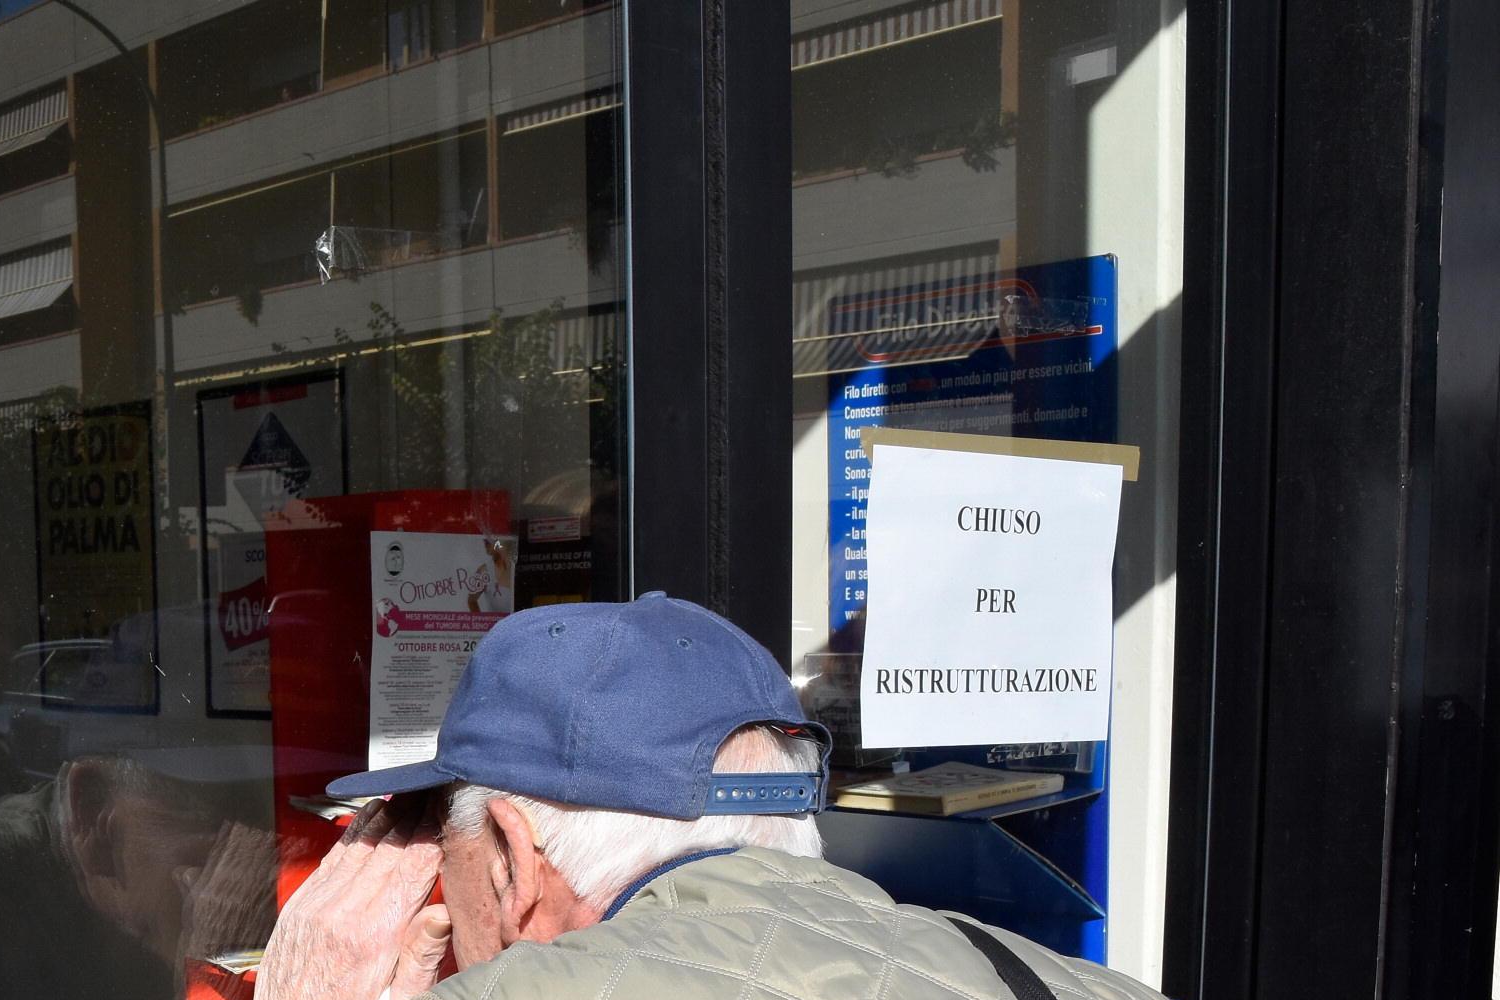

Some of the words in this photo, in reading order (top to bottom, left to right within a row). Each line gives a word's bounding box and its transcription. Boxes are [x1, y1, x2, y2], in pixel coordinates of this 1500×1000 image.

[844, 385, 860, 400] Filo
[861, 382, 889, 398] diretto
[891, 382, 907, 394] con
[941, 377, 953, 389] un
[955, 372, 981, 387] modo
[982, 370, 992, 384] in
[994, 367, 1009, 386] più
[1011, 369, 1027, 384] per
[1028, 364, 1062, 379] essere
[844, 403, 890, 420] Conoscere
[844, 426, 861, 440] Non
[1034, 405, 1080, 422] domande
[1081, 406, 1088, 417] e
[844, 466, 866, 481] Sono
[48, 473, 105, 509] OLIO
[114, 470, 140, 506] DI
[858, 488, 870, 503] pu
[957, 506, 1041, 535] CHIUSO
[50, 515, 140, 554] PALMA
[245, 549, 267, 563] SCO
[844, 547, 868, 561] Quals
[845, 569, 856, 581] un
[858, 569, 869, 581] se
[844, 587, 851, 601] E
[854, 589, 865, 601] se
[975, 588, 1017, 614] PER
[225, 595, 269, 641] 40%
[439, 643, 461, 652] ROSA
[462, 640, 477, 652] 20
[875, 668, 1097, 694] RISTRUTTURAZIONE
